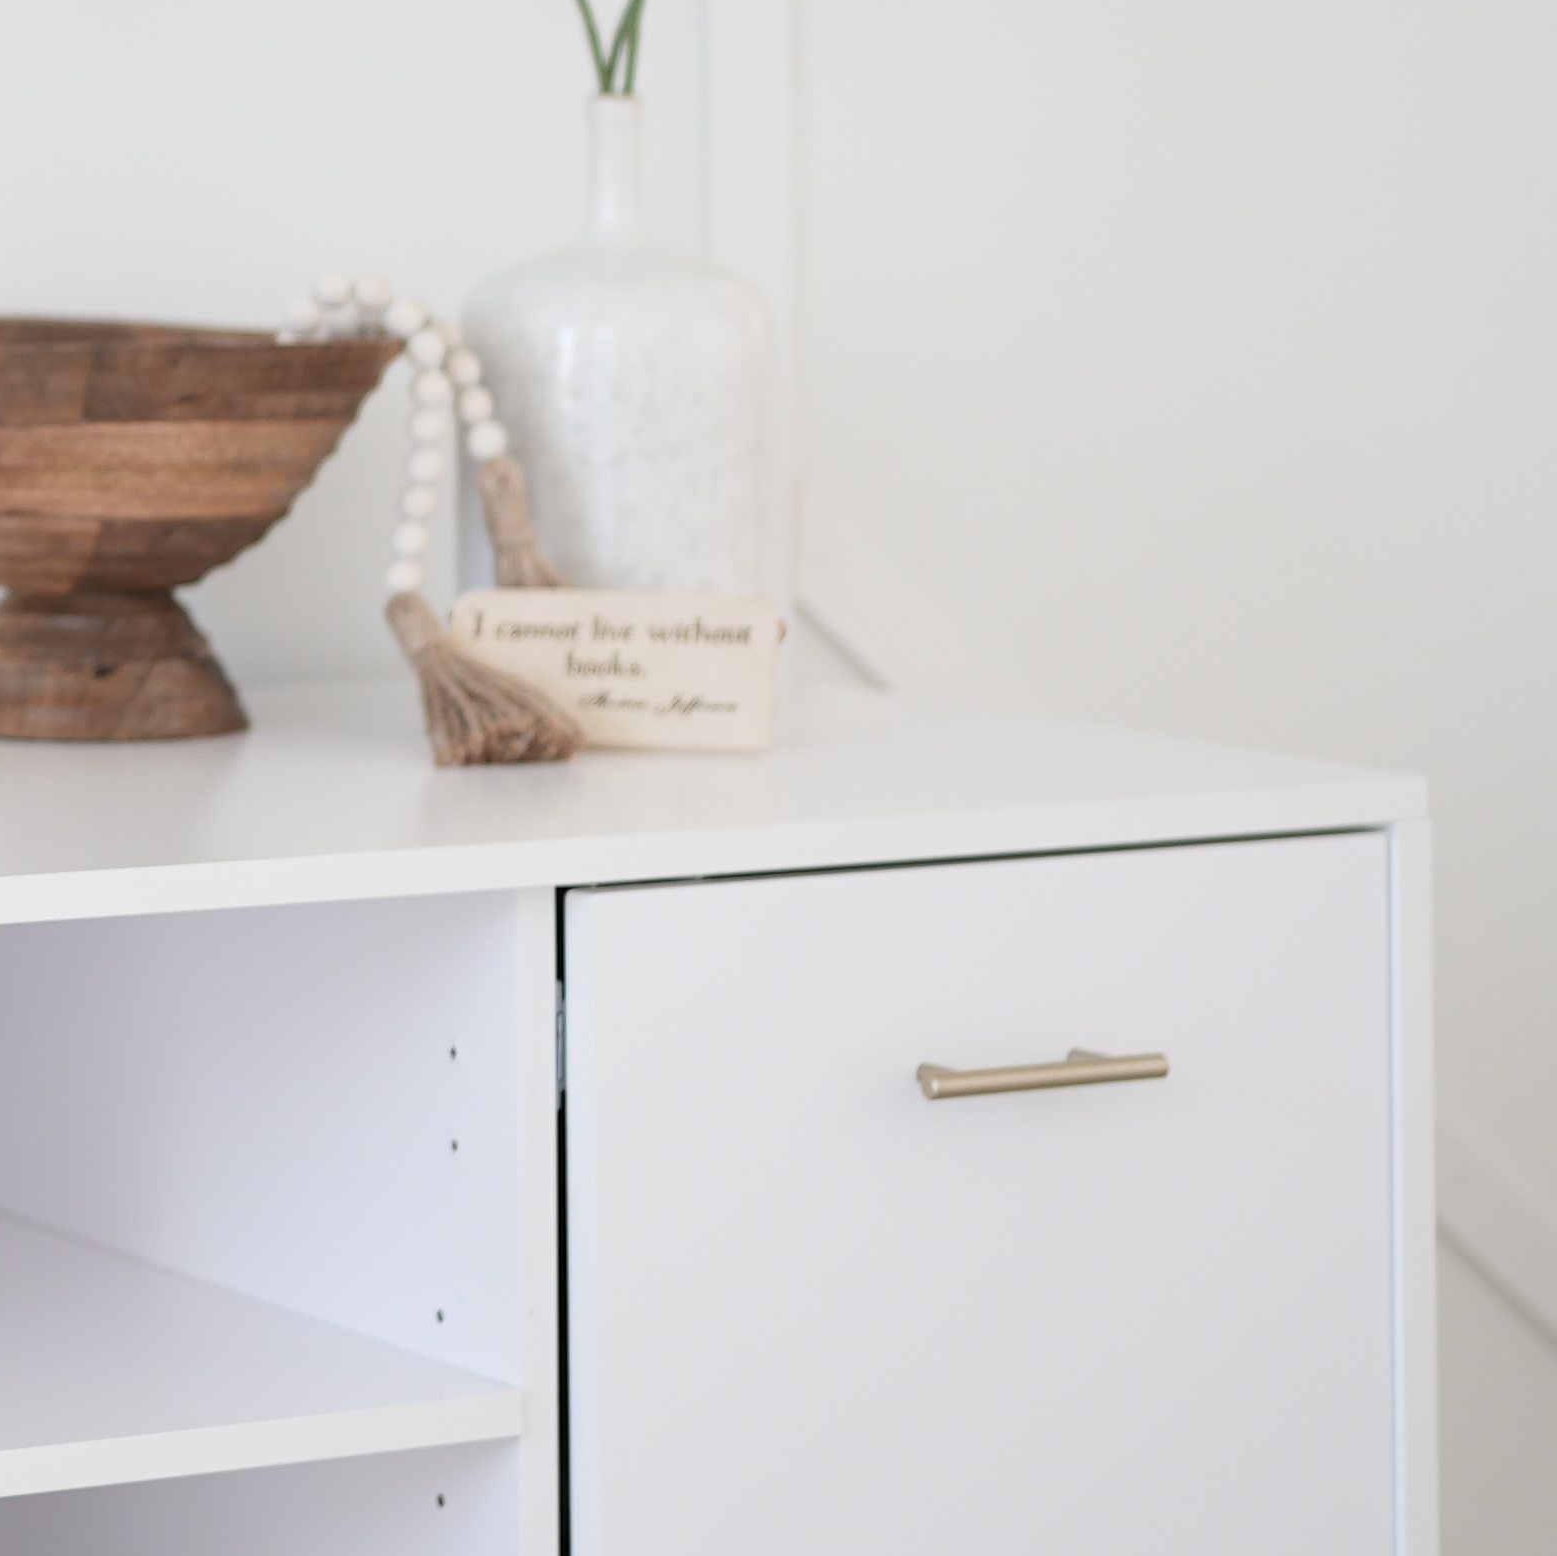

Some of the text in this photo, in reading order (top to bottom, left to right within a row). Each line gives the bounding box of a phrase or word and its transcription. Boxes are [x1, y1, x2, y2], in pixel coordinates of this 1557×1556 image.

[472, 609, 754, 645] I cannot live without
